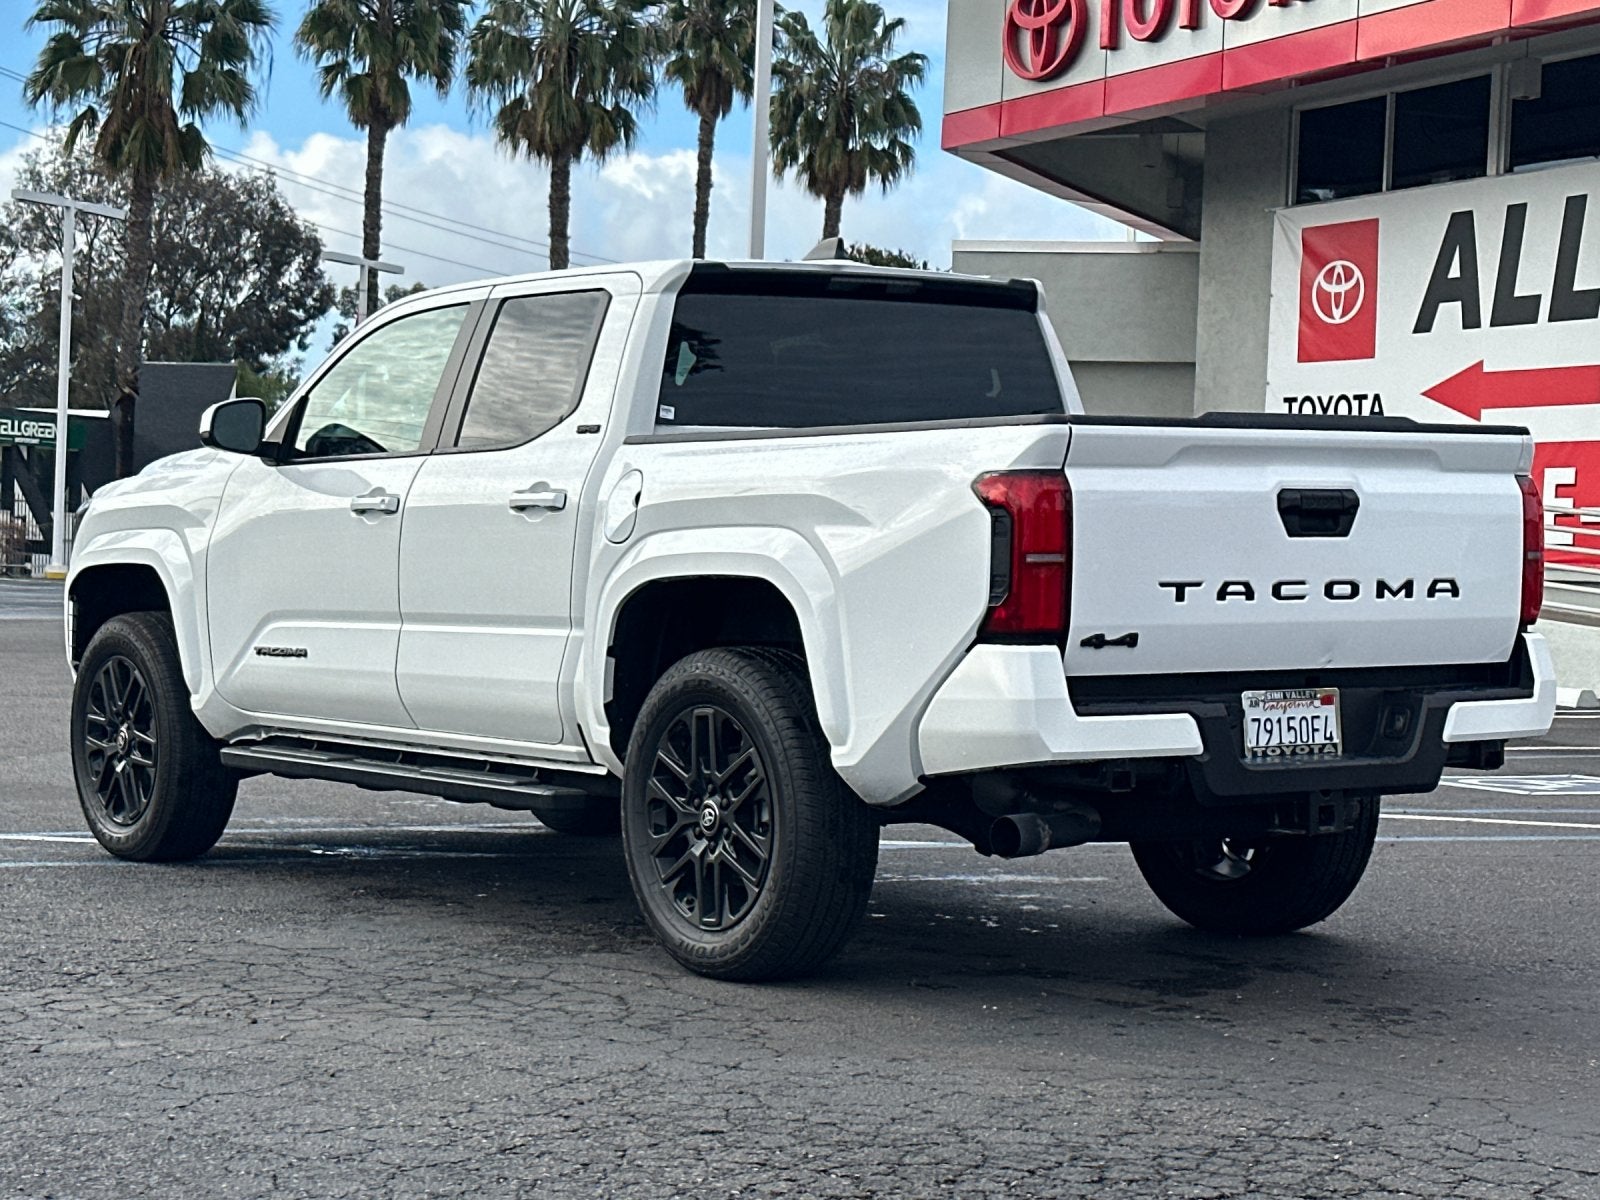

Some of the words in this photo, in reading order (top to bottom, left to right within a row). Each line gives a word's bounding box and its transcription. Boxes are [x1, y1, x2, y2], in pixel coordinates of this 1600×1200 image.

[1412, 193, 1600, 334] ALL
[1158, 577, 1461, 603] TACOMA
[254, 646, 308, 658] TACOMA
[1285, 689, 1316, 699] VALLEY
[1251, 715, 1334, 746] 79150F4
[1253, 744, 1336, 757] TOYOTA
